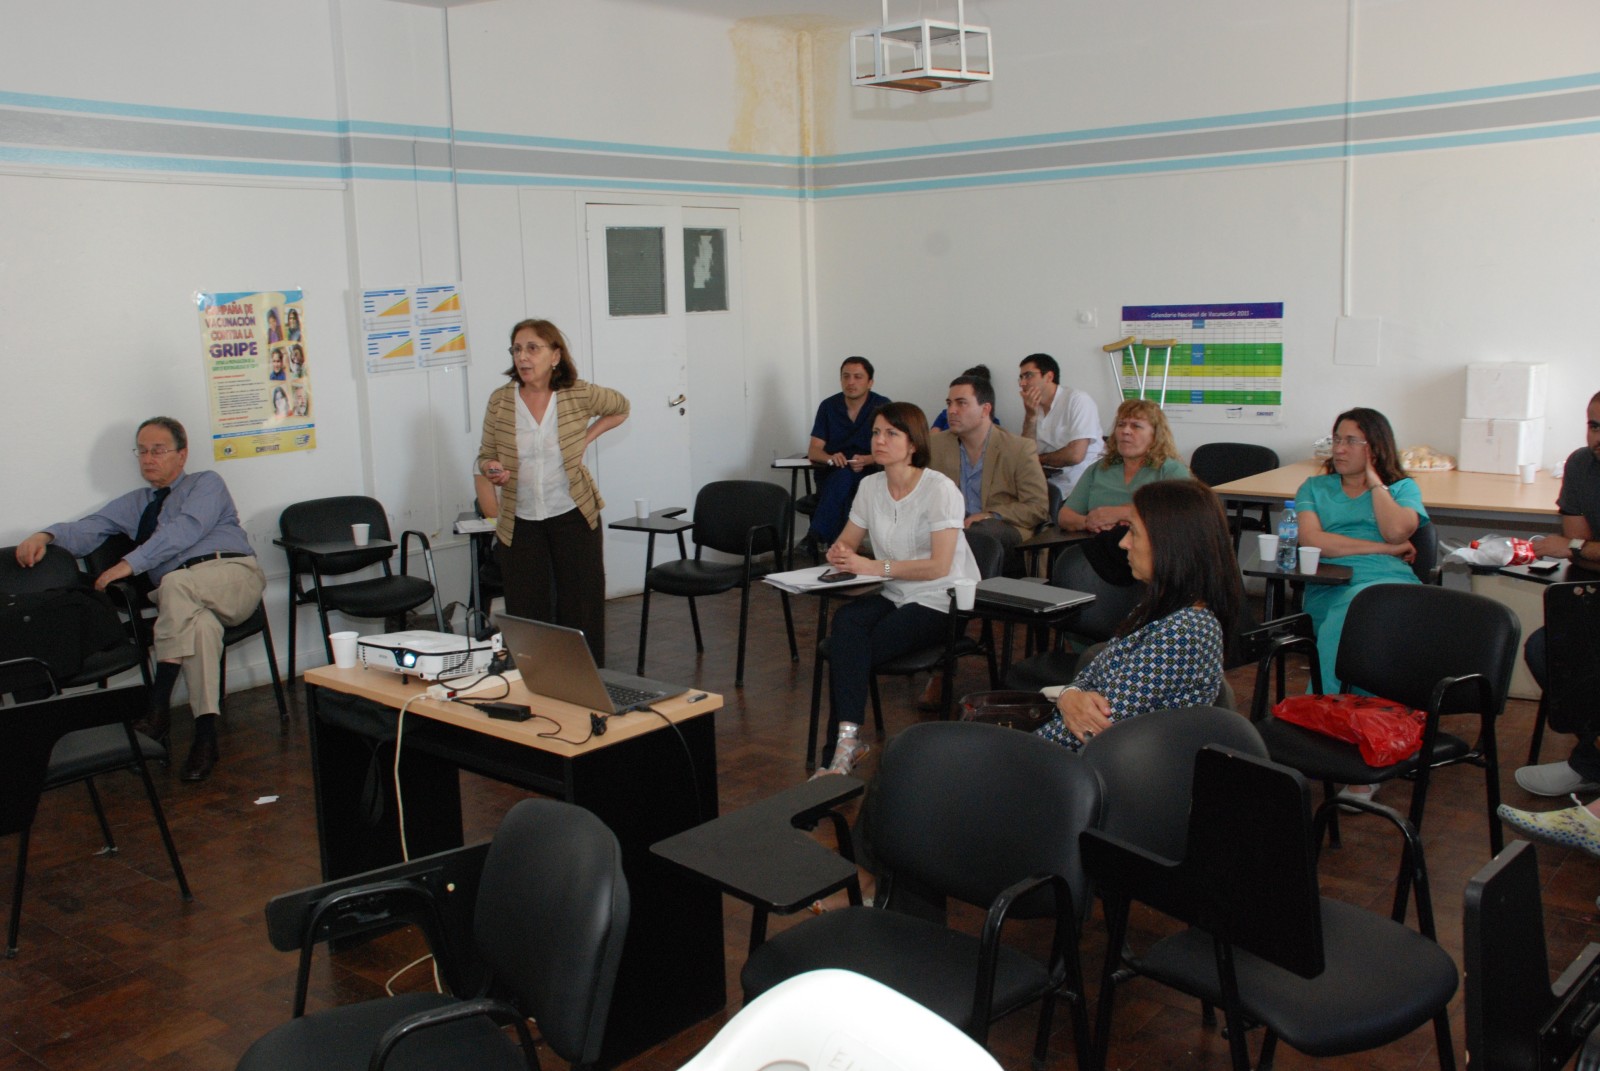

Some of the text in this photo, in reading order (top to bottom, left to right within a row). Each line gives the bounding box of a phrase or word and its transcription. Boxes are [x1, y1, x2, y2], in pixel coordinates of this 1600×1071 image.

[244, 304, 254, 314] DE
[244, 328, 255, 339] LA
[209, 341, 258, 358] GRIPE
